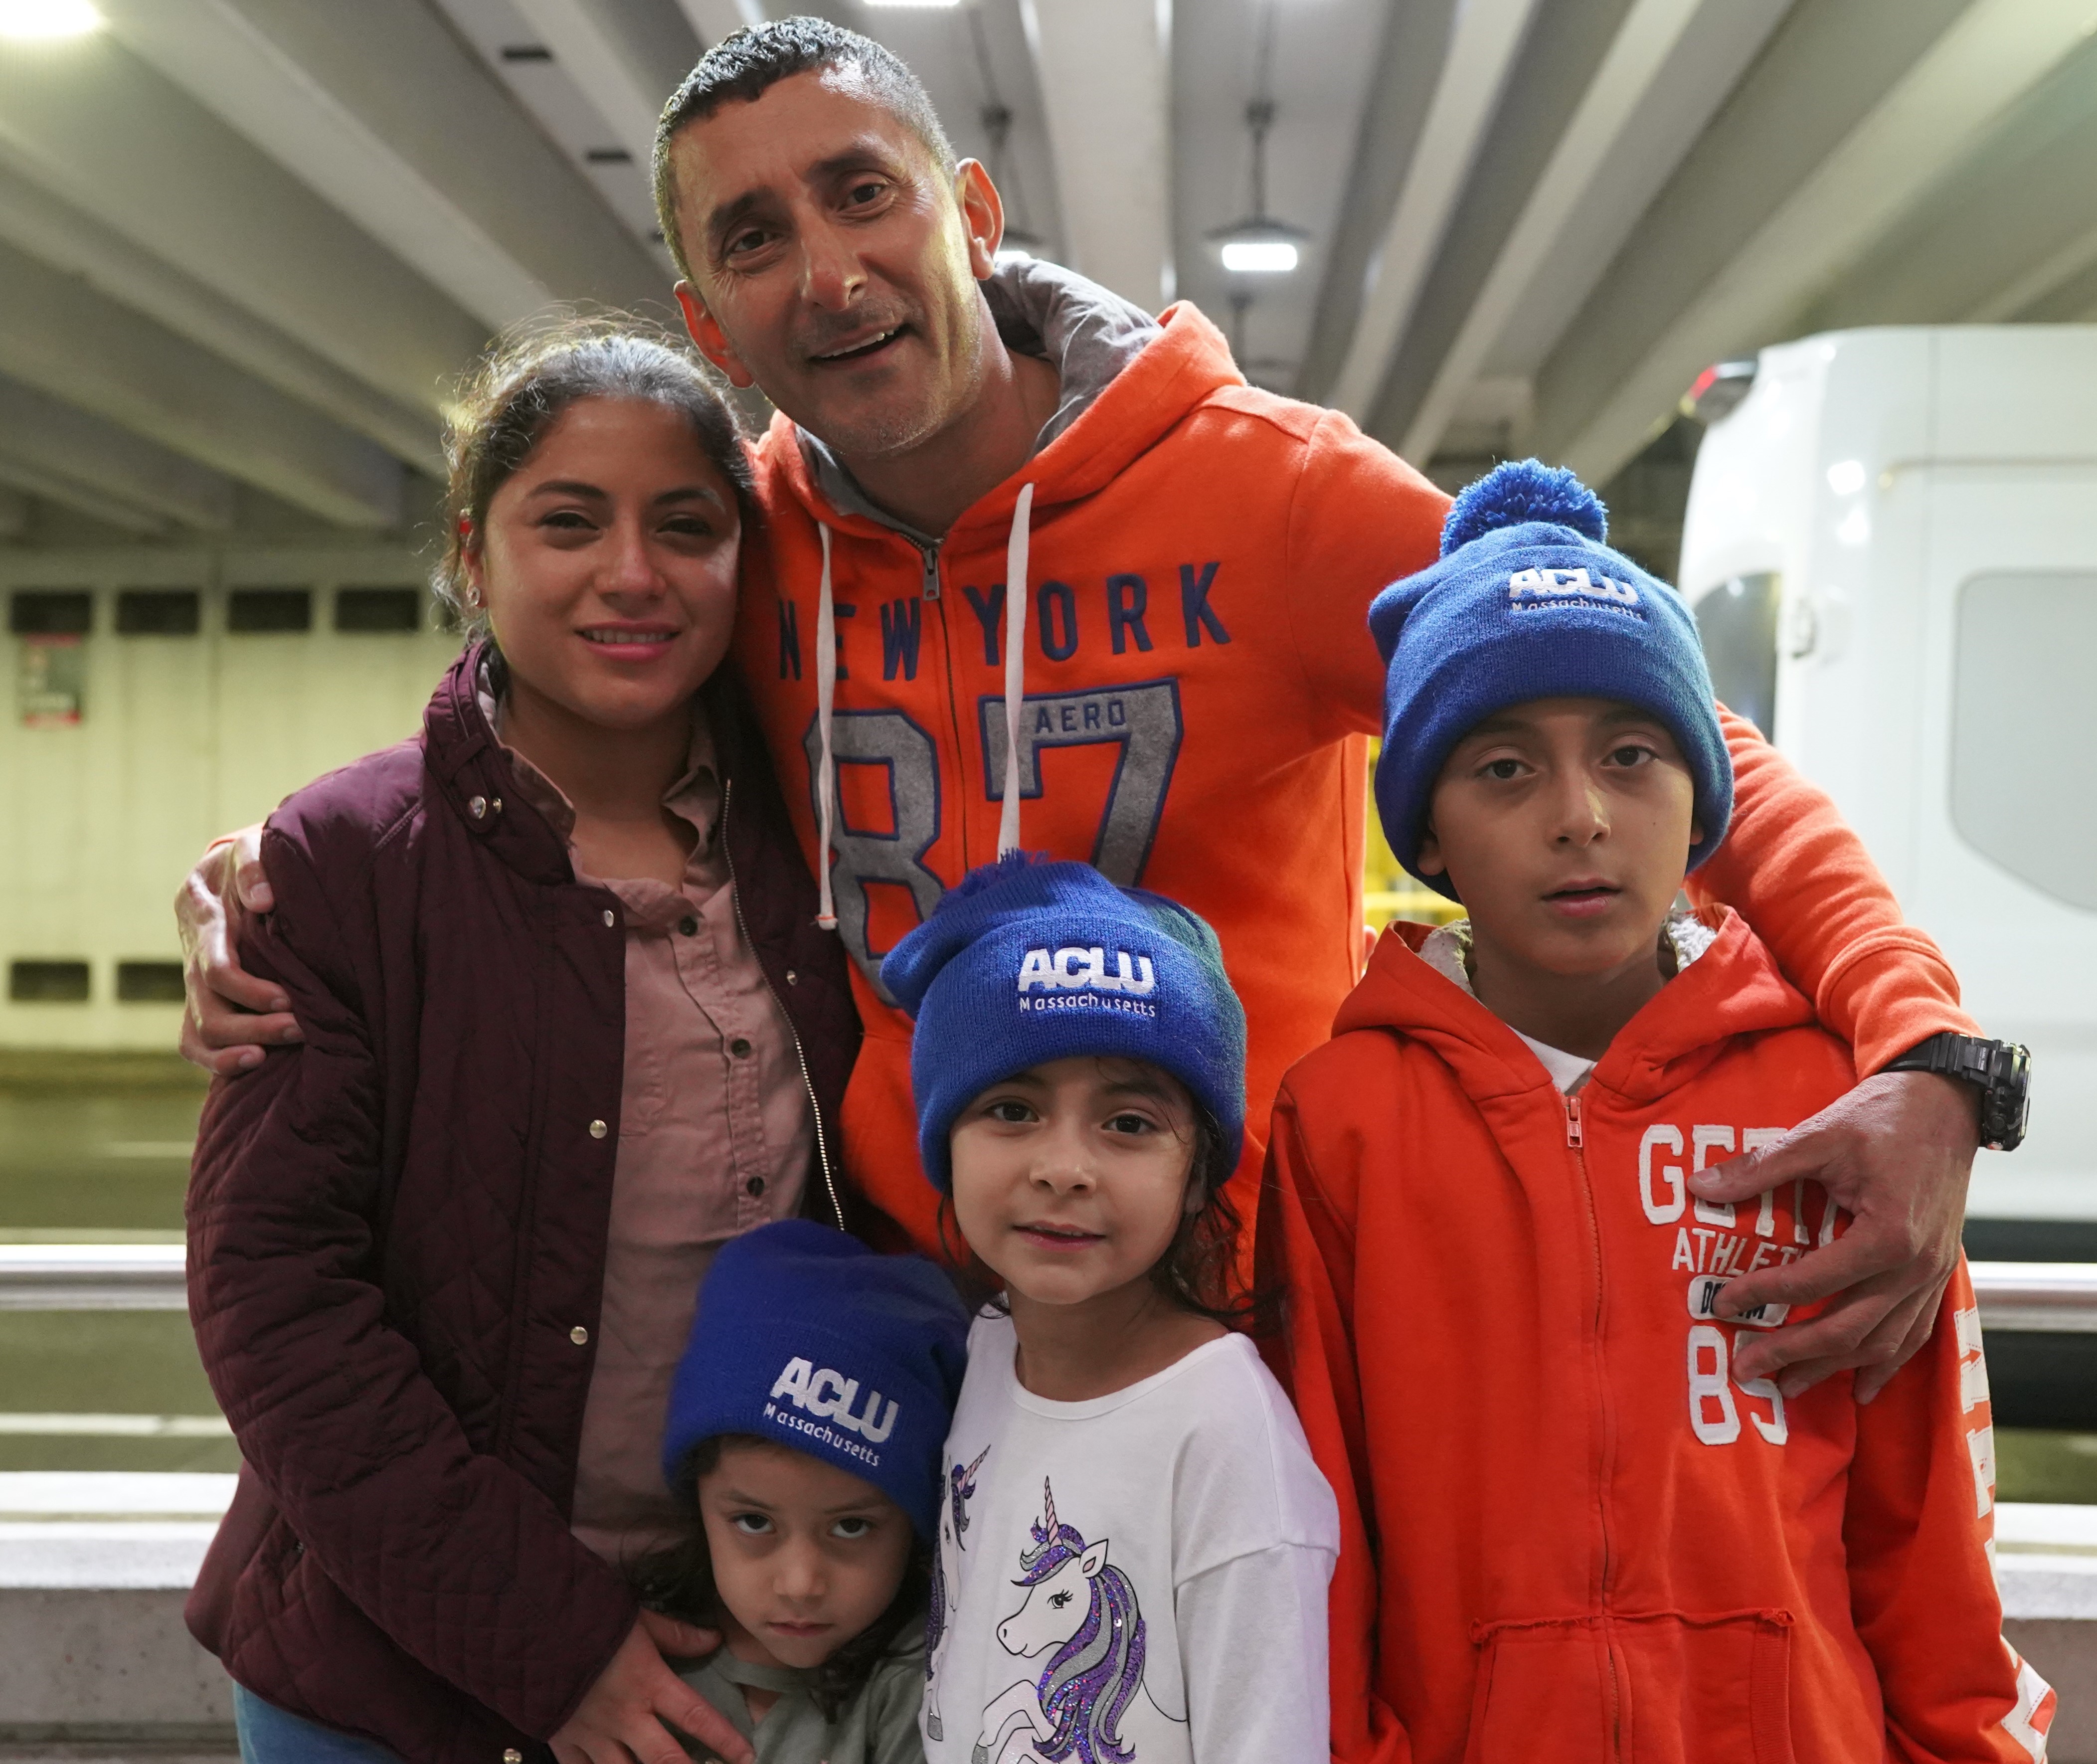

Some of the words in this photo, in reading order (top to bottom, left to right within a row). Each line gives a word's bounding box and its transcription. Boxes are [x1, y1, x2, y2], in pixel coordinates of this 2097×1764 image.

[963, 561, 1231, 666] YORK
[1509, 568, 1639, 605] ACLU
[1035, 700, 1126, 733] AERO
[803, 677, 1184, 1008] 87
[1018, 947, 1155, 994] ACLU
[1019, 992, 1156, 1017] Massachusetts
[1672, 1227, 1804, 1275] ATHLET
[769, 1356, 899, 1443] ACLU
[1687, 1325, 1788, 1446] 85
[763, 1402, 880, 1467] Massachusetts
